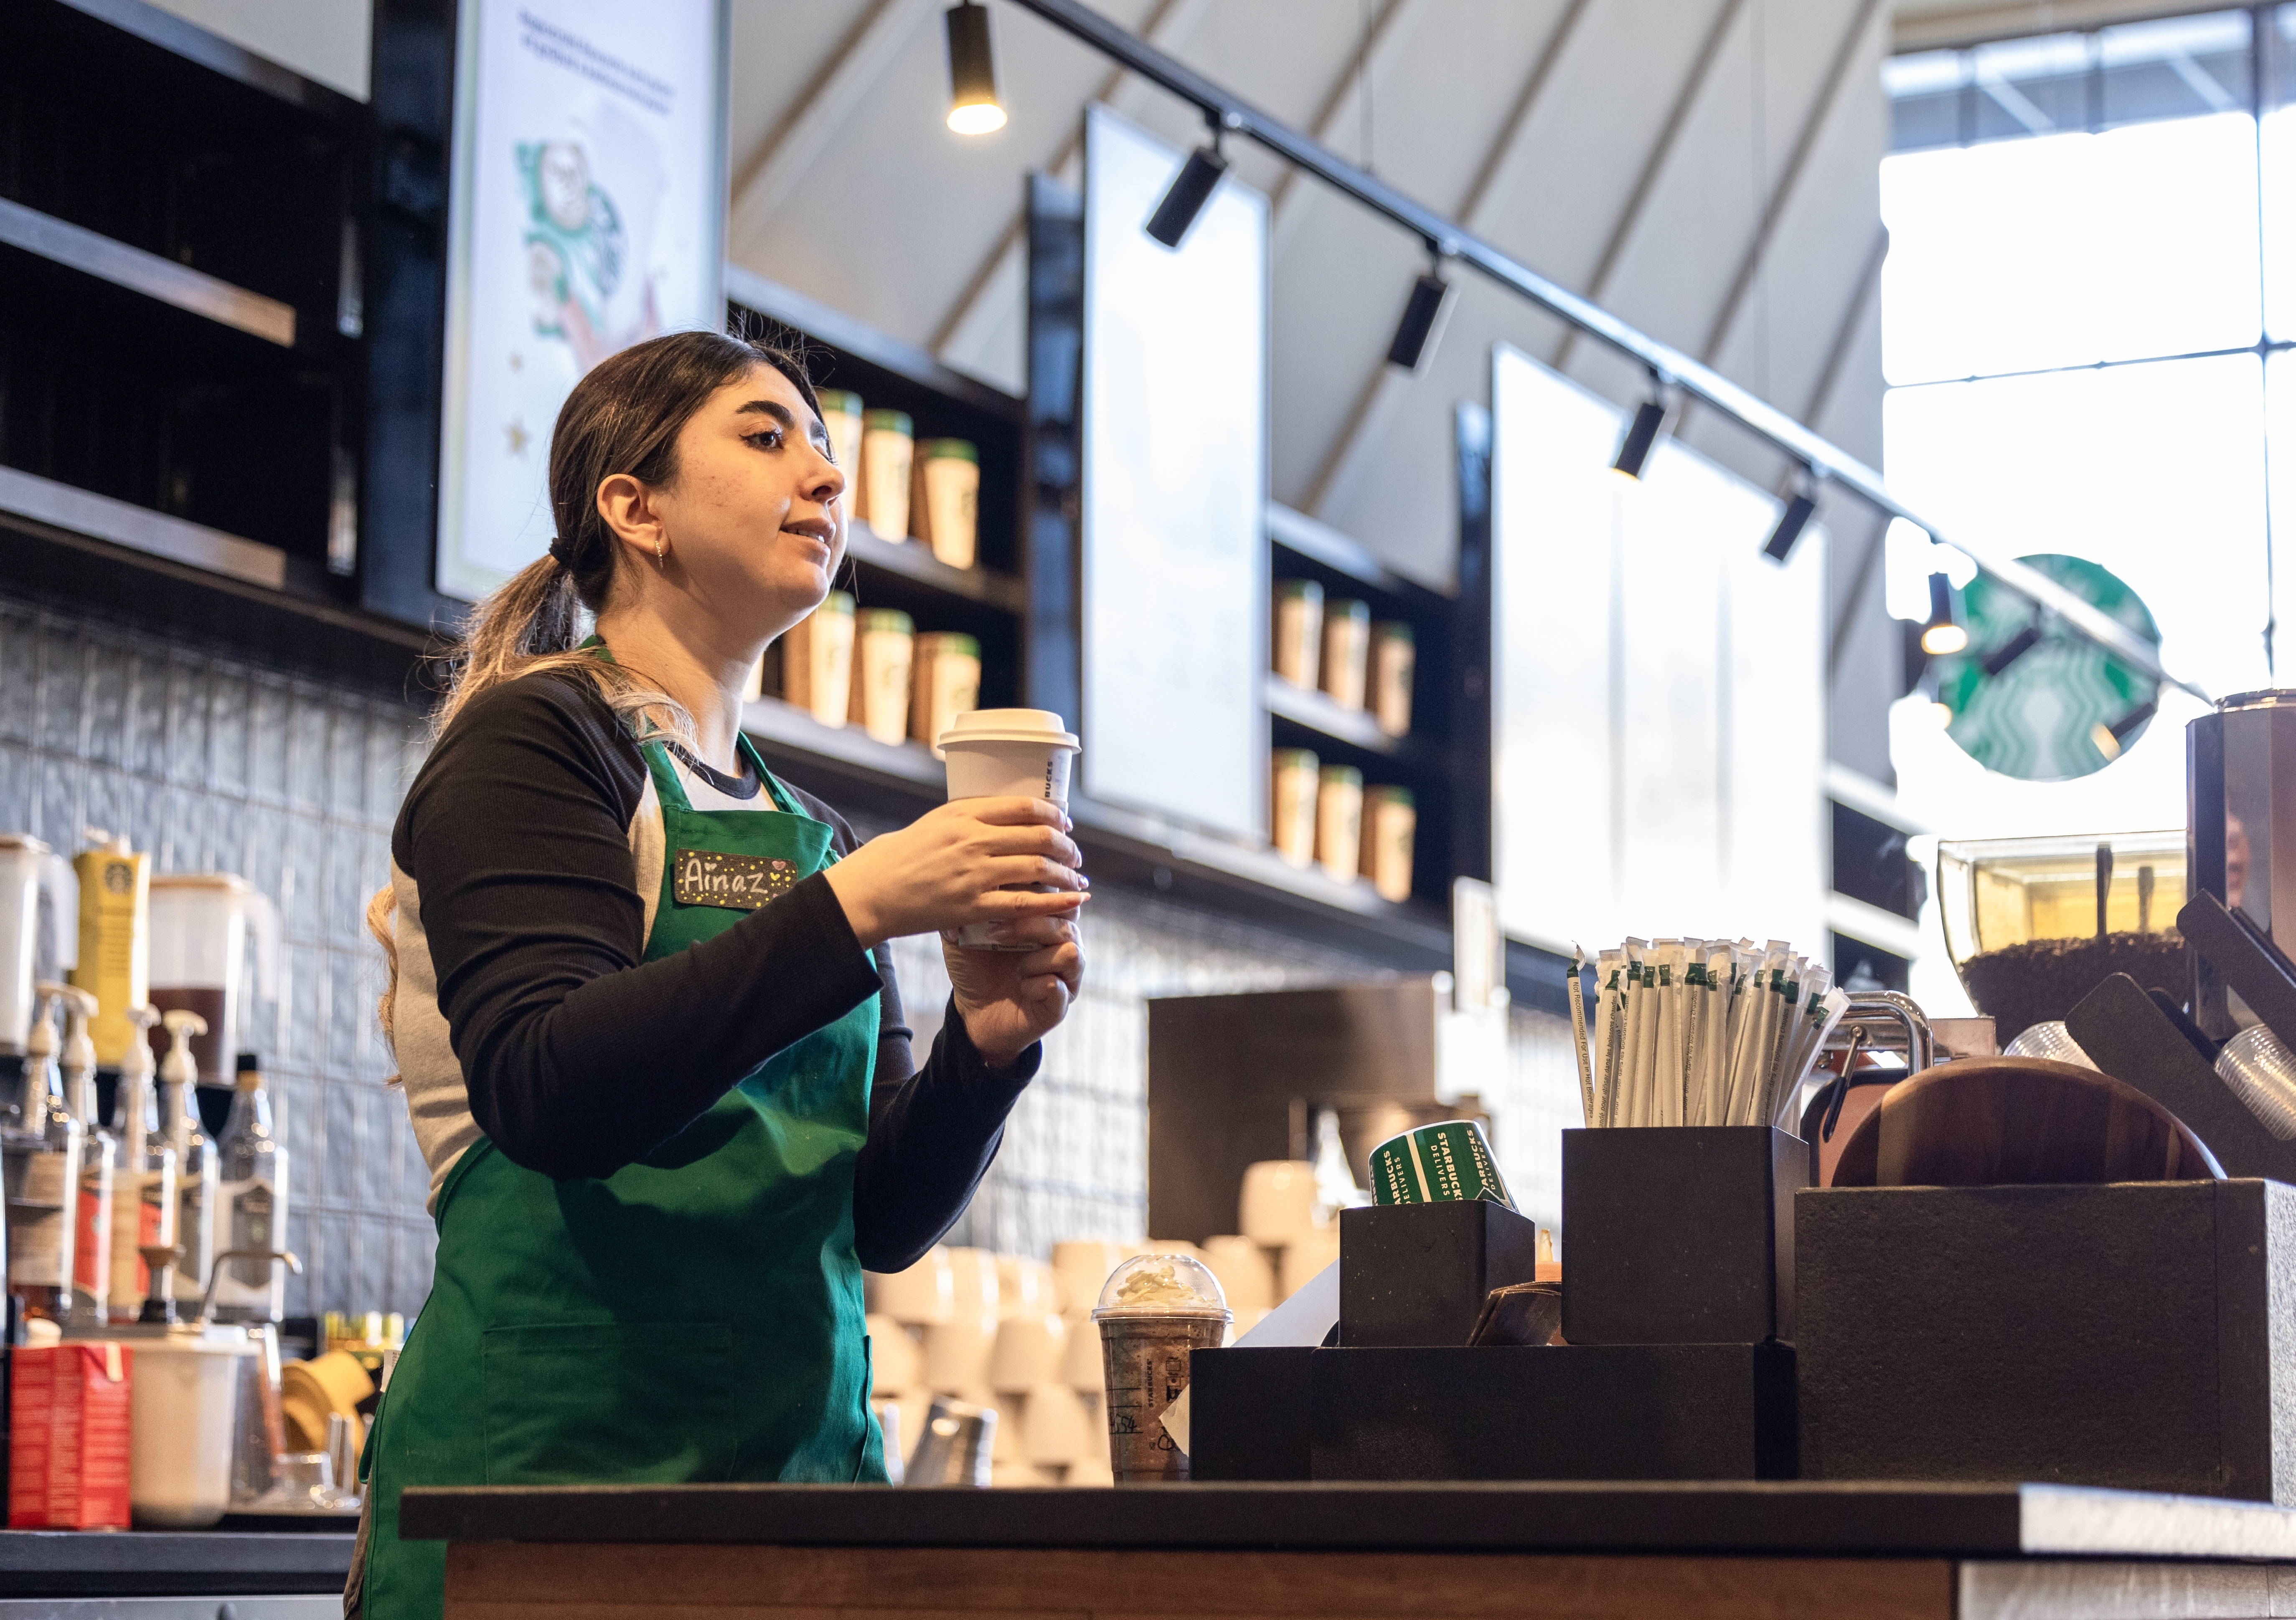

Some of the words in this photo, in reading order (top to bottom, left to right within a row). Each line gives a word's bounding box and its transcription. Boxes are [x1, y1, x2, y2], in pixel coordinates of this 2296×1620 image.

[685, 858, 768, 894] Ainaz
[1575, 994, 1585, 1040] Recommended
[1384, 1151, 1402, 1204] ARBUCKS
[1431, 1145, 1450, 1196] DELIVERS
[1467, 1130, 1488, 1186] ARBUCKS
[1478, 1141, 1496, 1190] DELIVERS
